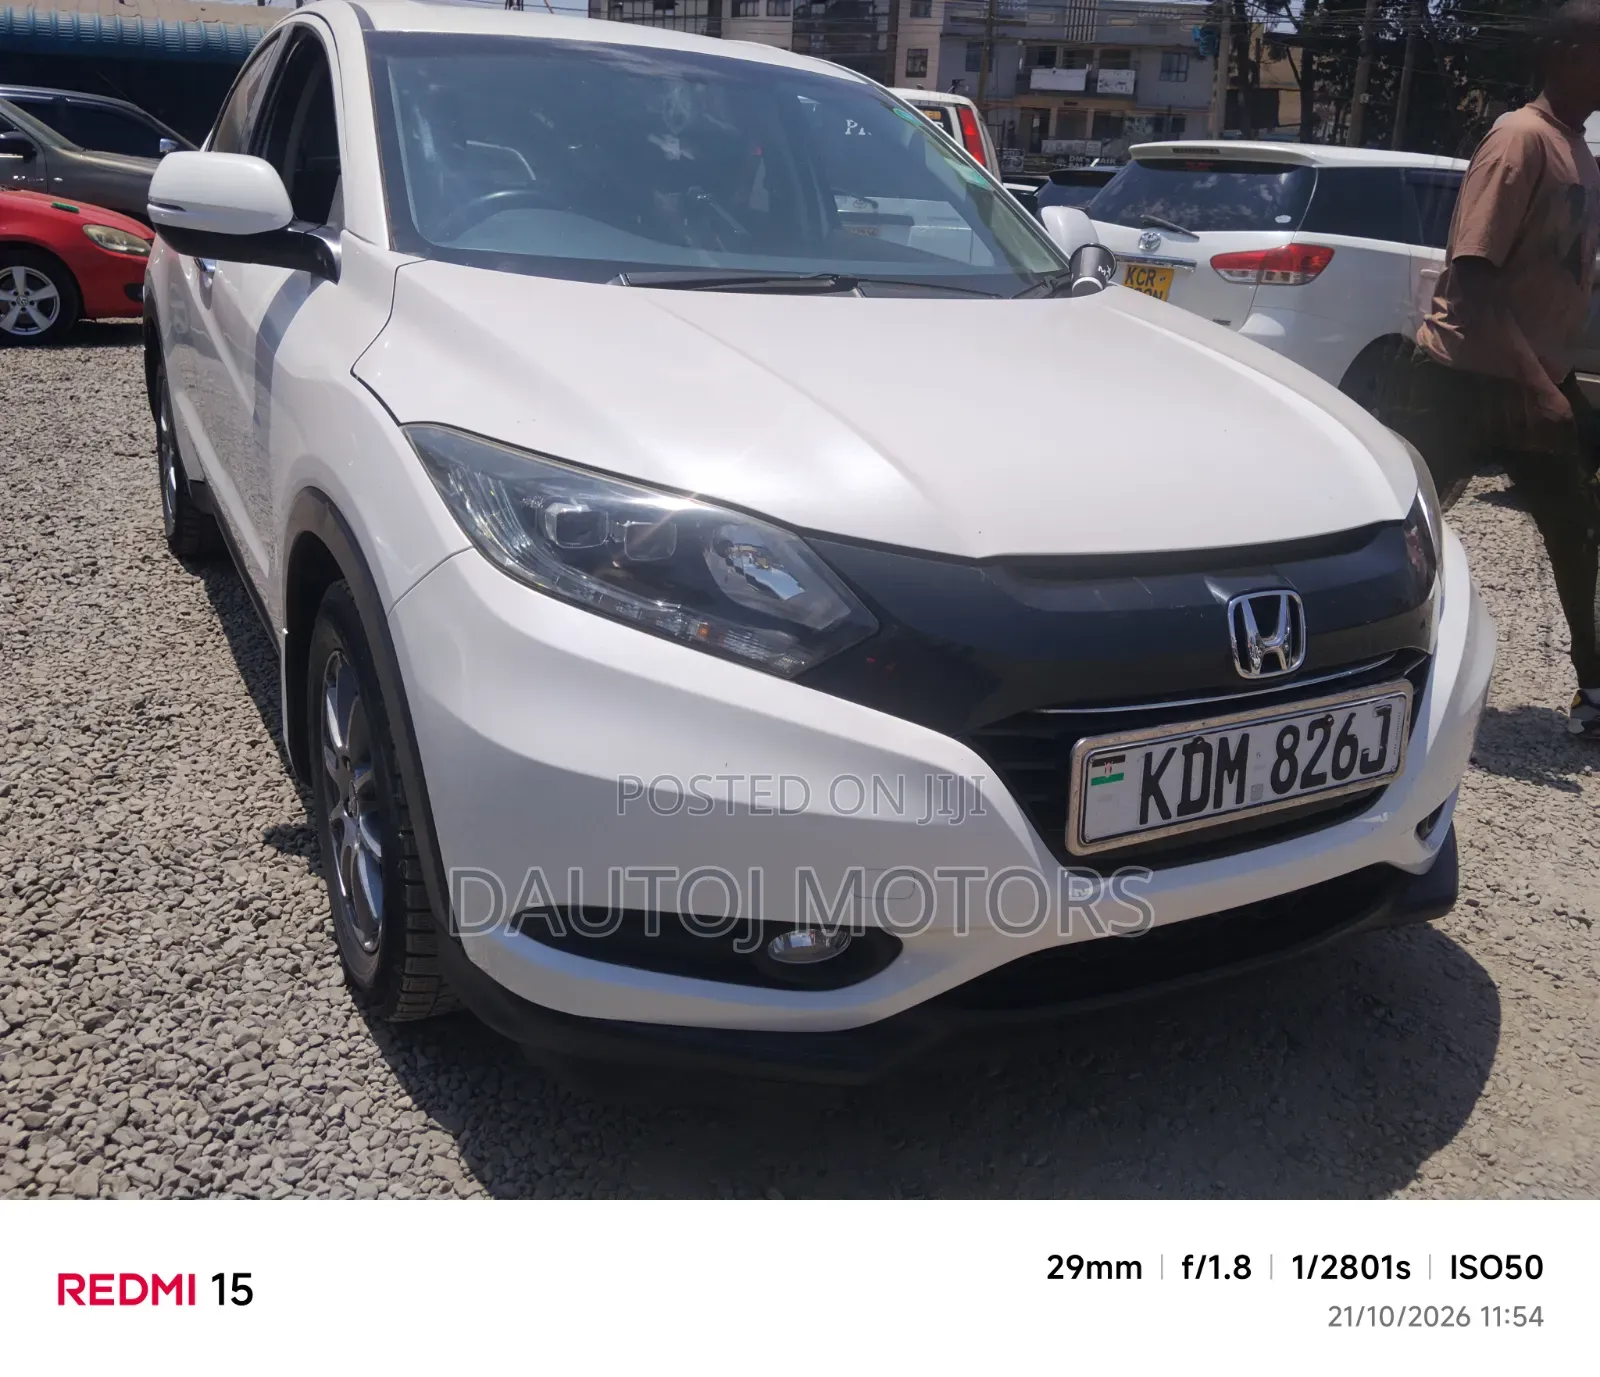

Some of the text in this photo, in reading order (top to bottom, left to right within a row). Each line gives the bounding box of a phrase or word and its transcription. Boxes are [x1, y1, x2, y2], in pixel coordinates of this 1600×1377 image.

[1094, 156, 1116, 165] AIR
[1125, 266, 1156, 287] KCR
[1139, 733, 1250, 826] KDM
[1270, 704, 1393, 795] 826J
